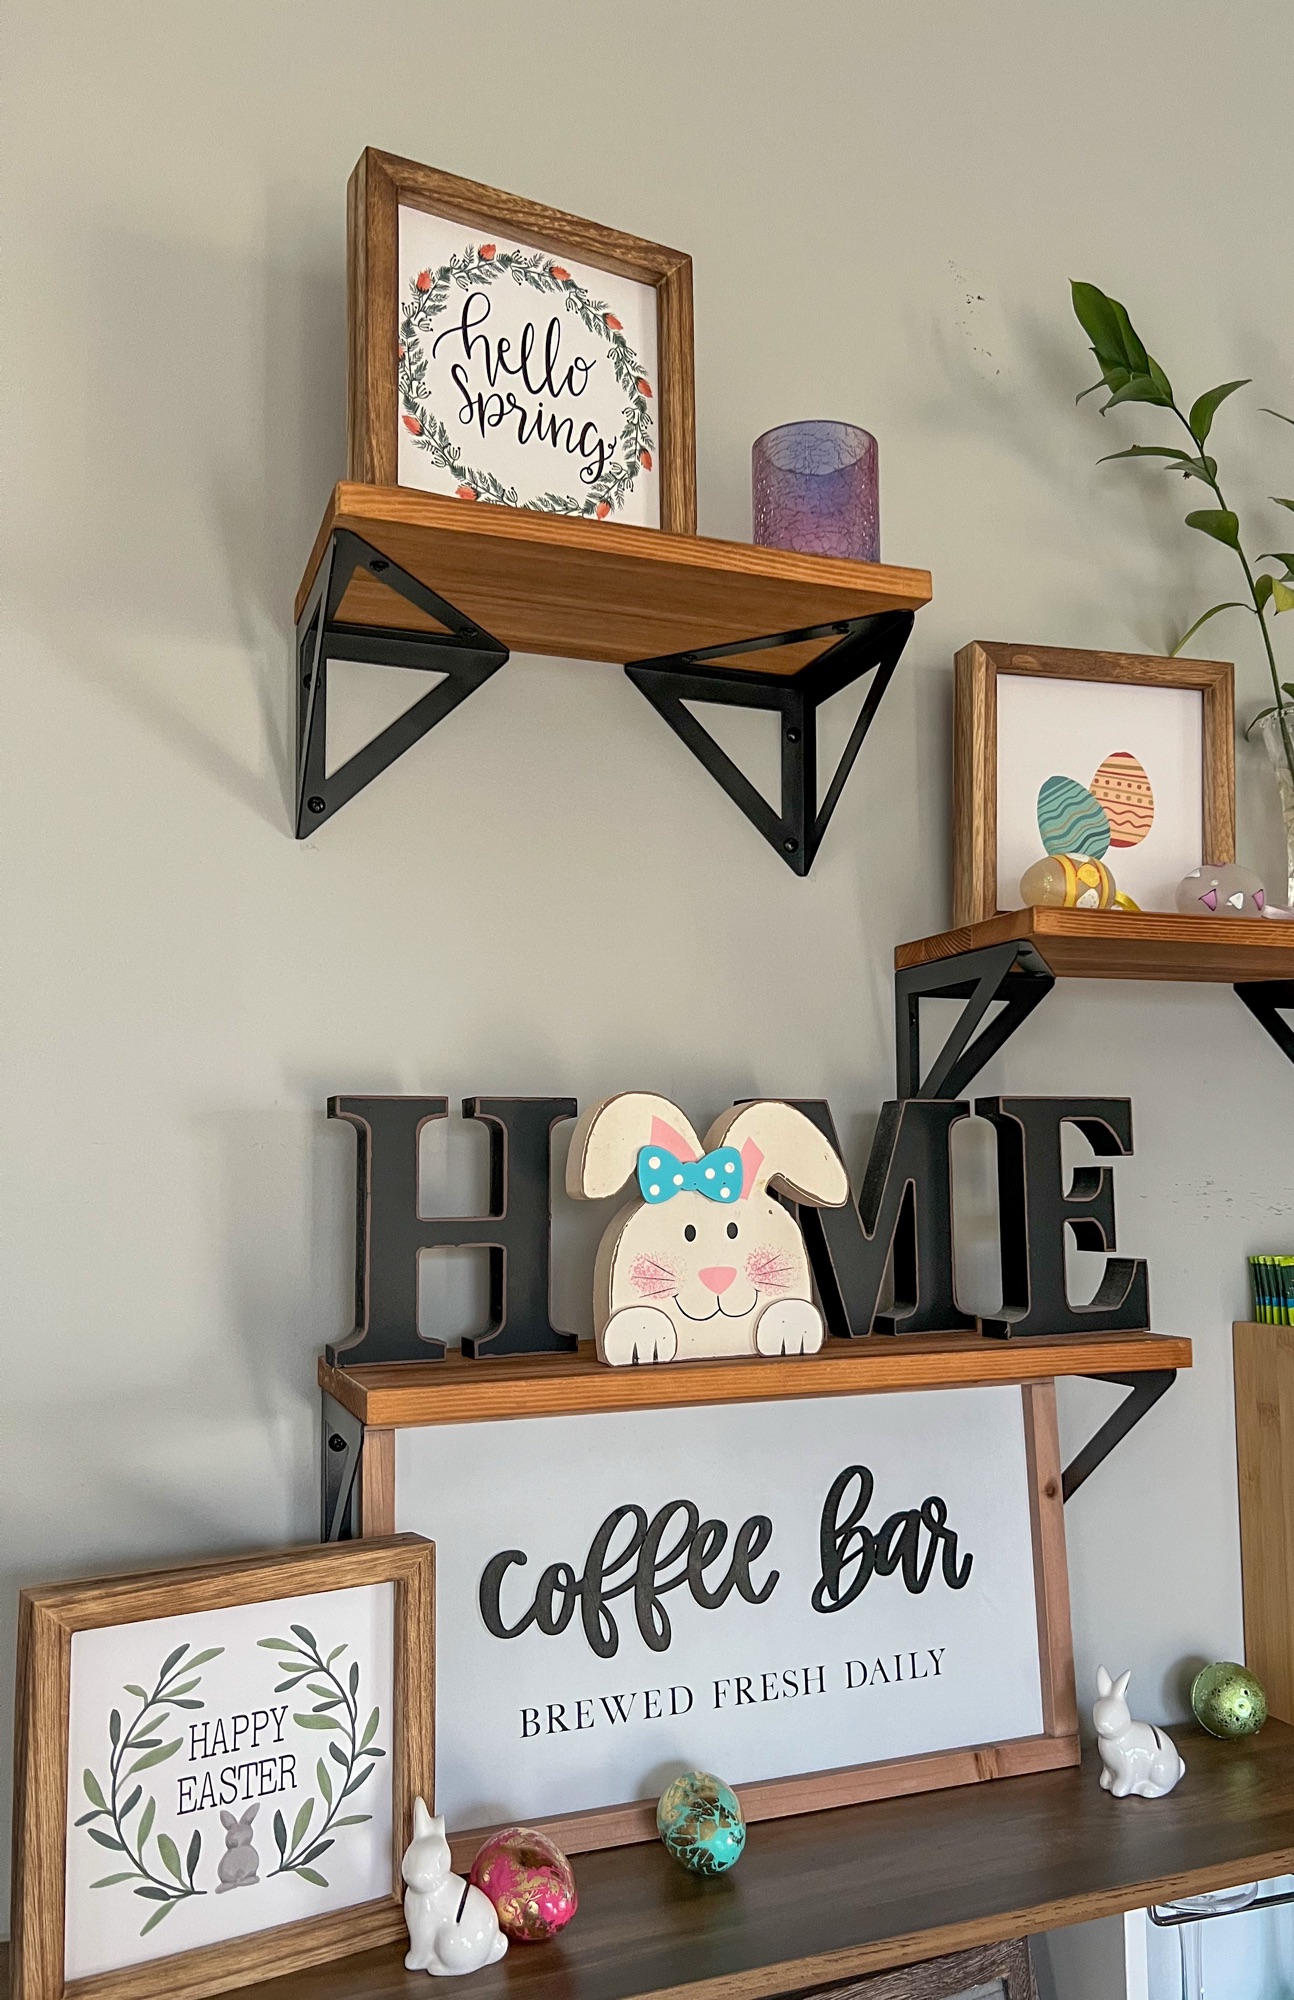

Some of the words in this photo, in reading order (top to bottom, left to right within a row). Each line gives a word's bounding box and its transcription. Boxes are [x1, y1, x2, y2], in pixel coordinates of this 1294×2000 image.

[432, 292, 597, 398] hello
[450, 363, 617, 485] spring
[478, 1499, 780, 1659] coffee
[811, 1464, 974, 1614] bar
[188, 1705, 289, 1761] HAPPY
[519, 1685, 694, 1739] BREWED
[712, 1665, 827, 1711] FRESH
[845, 1647, 947, 1690] DAILY
[176, 1754, 298, 1815] EASTER
